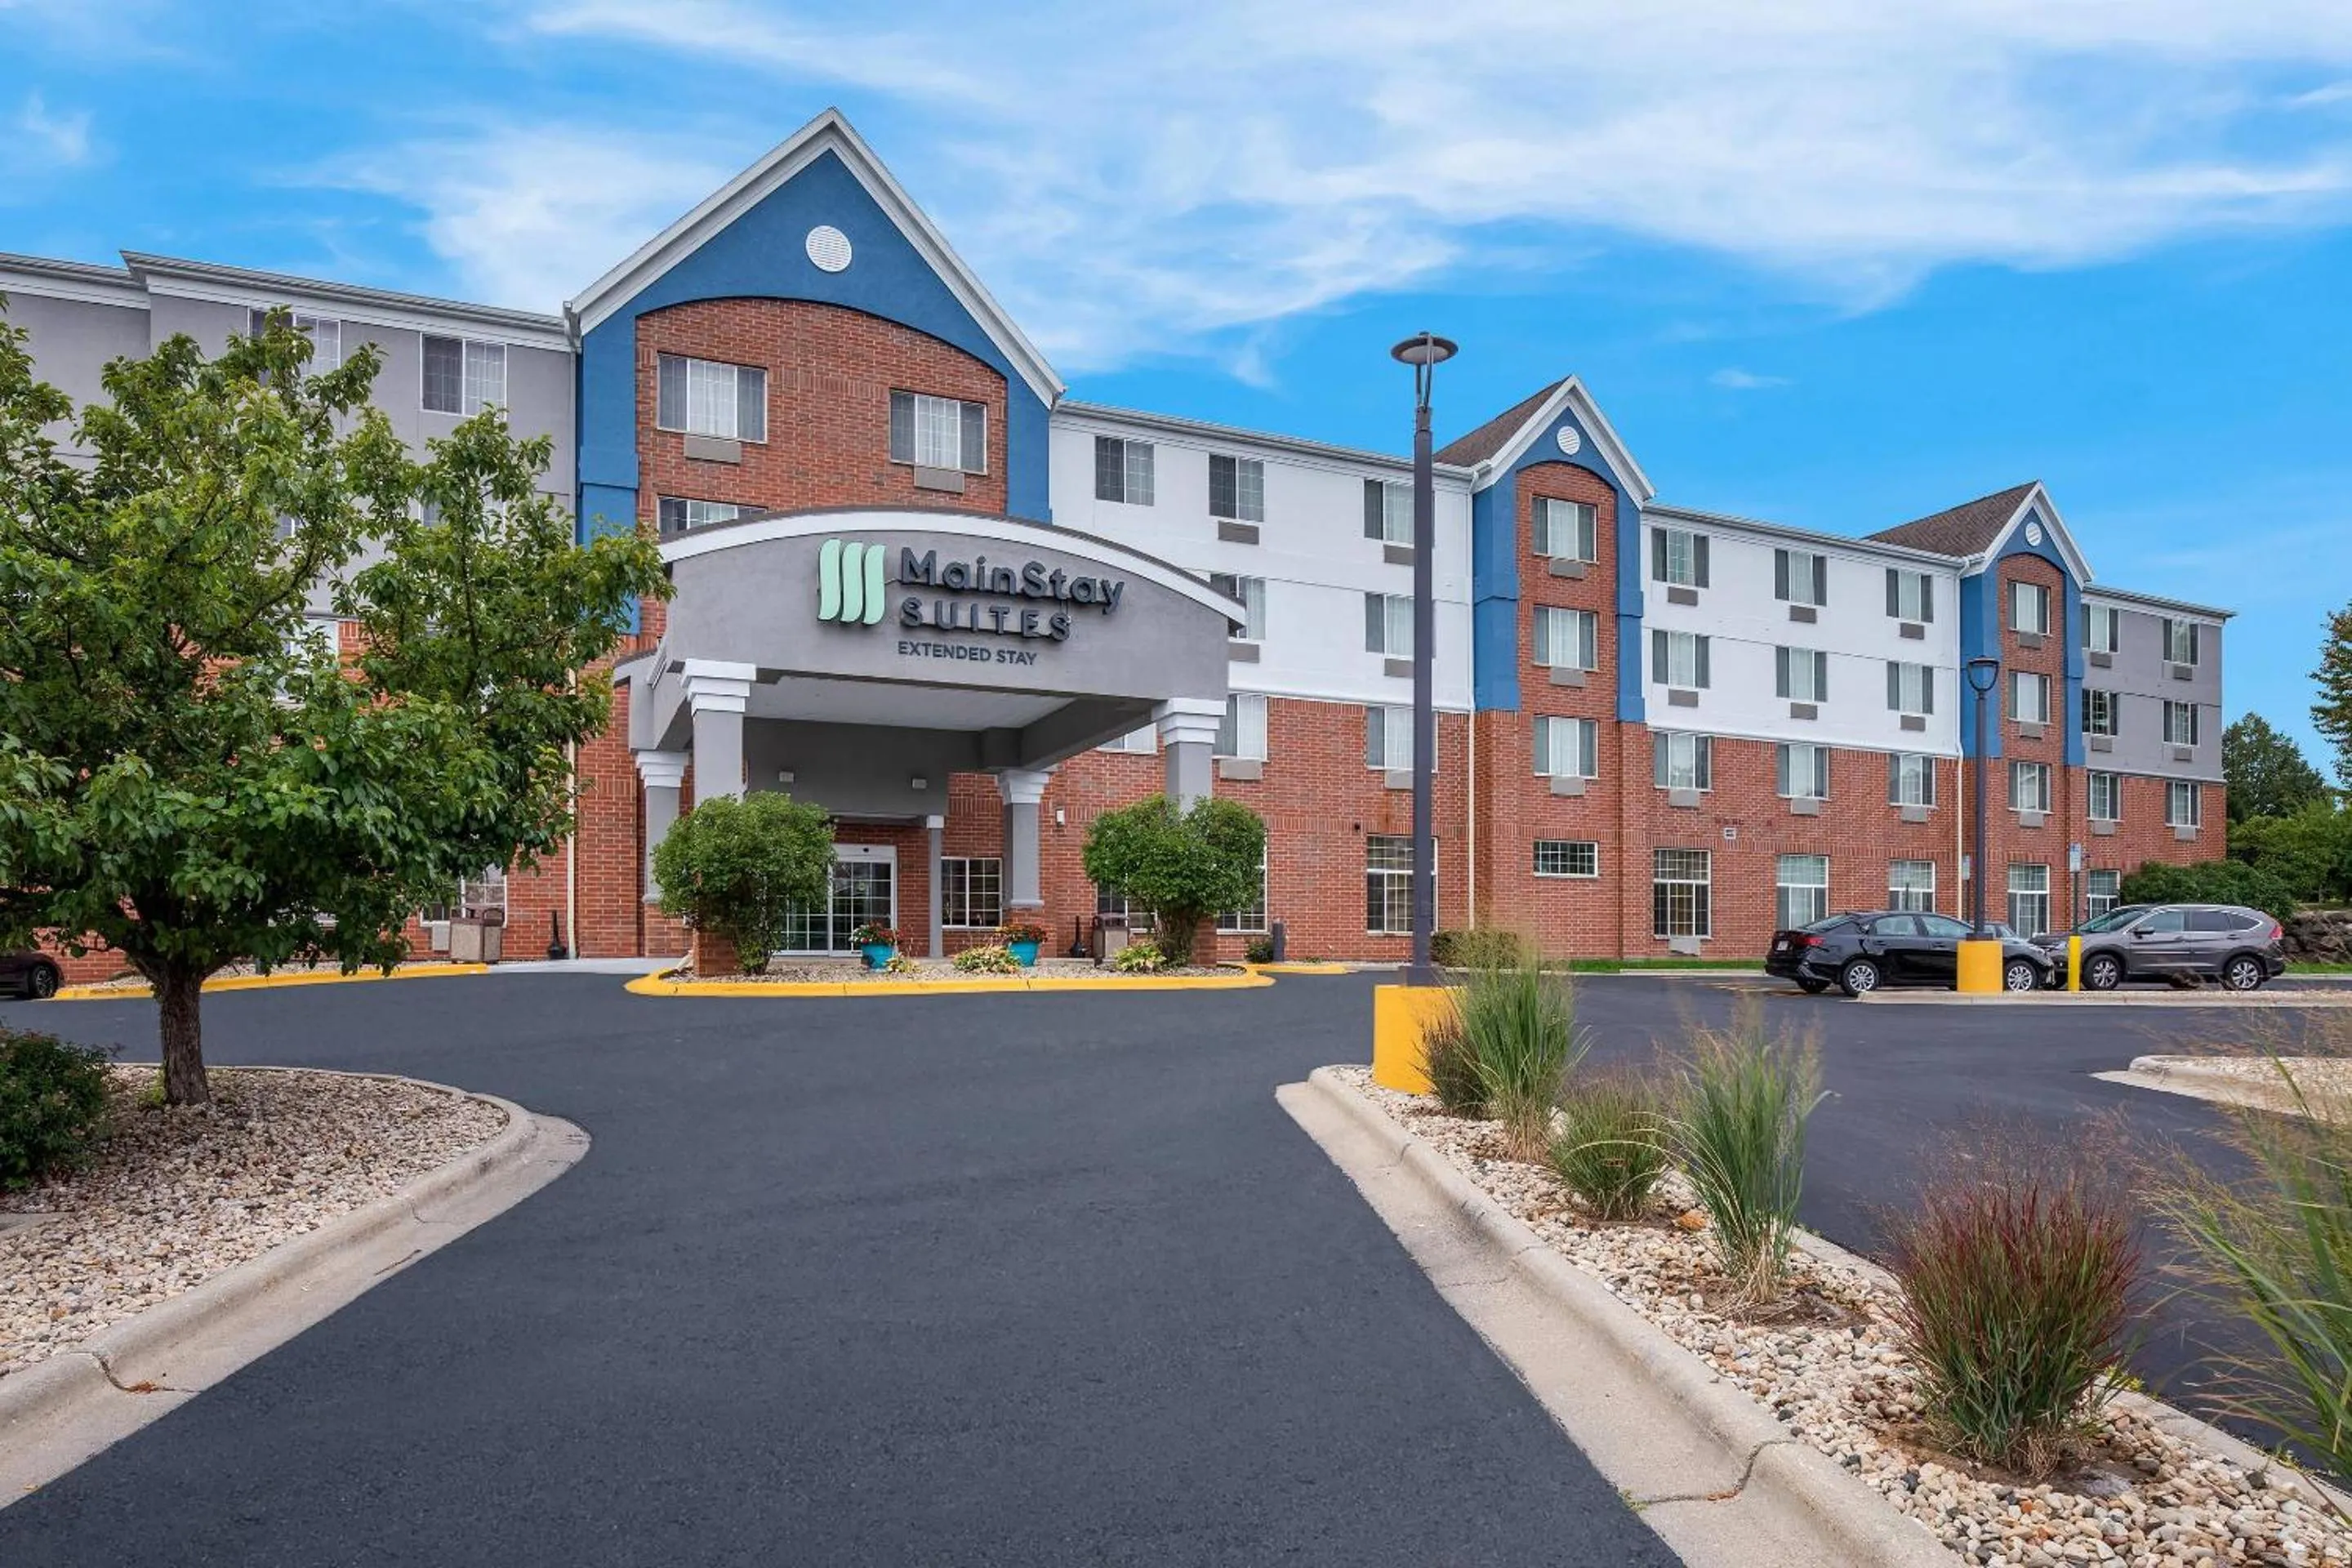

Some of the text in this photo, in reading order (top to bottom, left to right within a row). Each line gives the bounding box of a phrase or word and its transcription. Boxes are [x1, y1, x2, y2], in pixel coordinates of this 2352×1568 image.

[901, 546, 1125, 614] MainStay
[901, 596, 1071, 641] SUITES
[898, 641, 1037, 666] EXTENDED STAY
